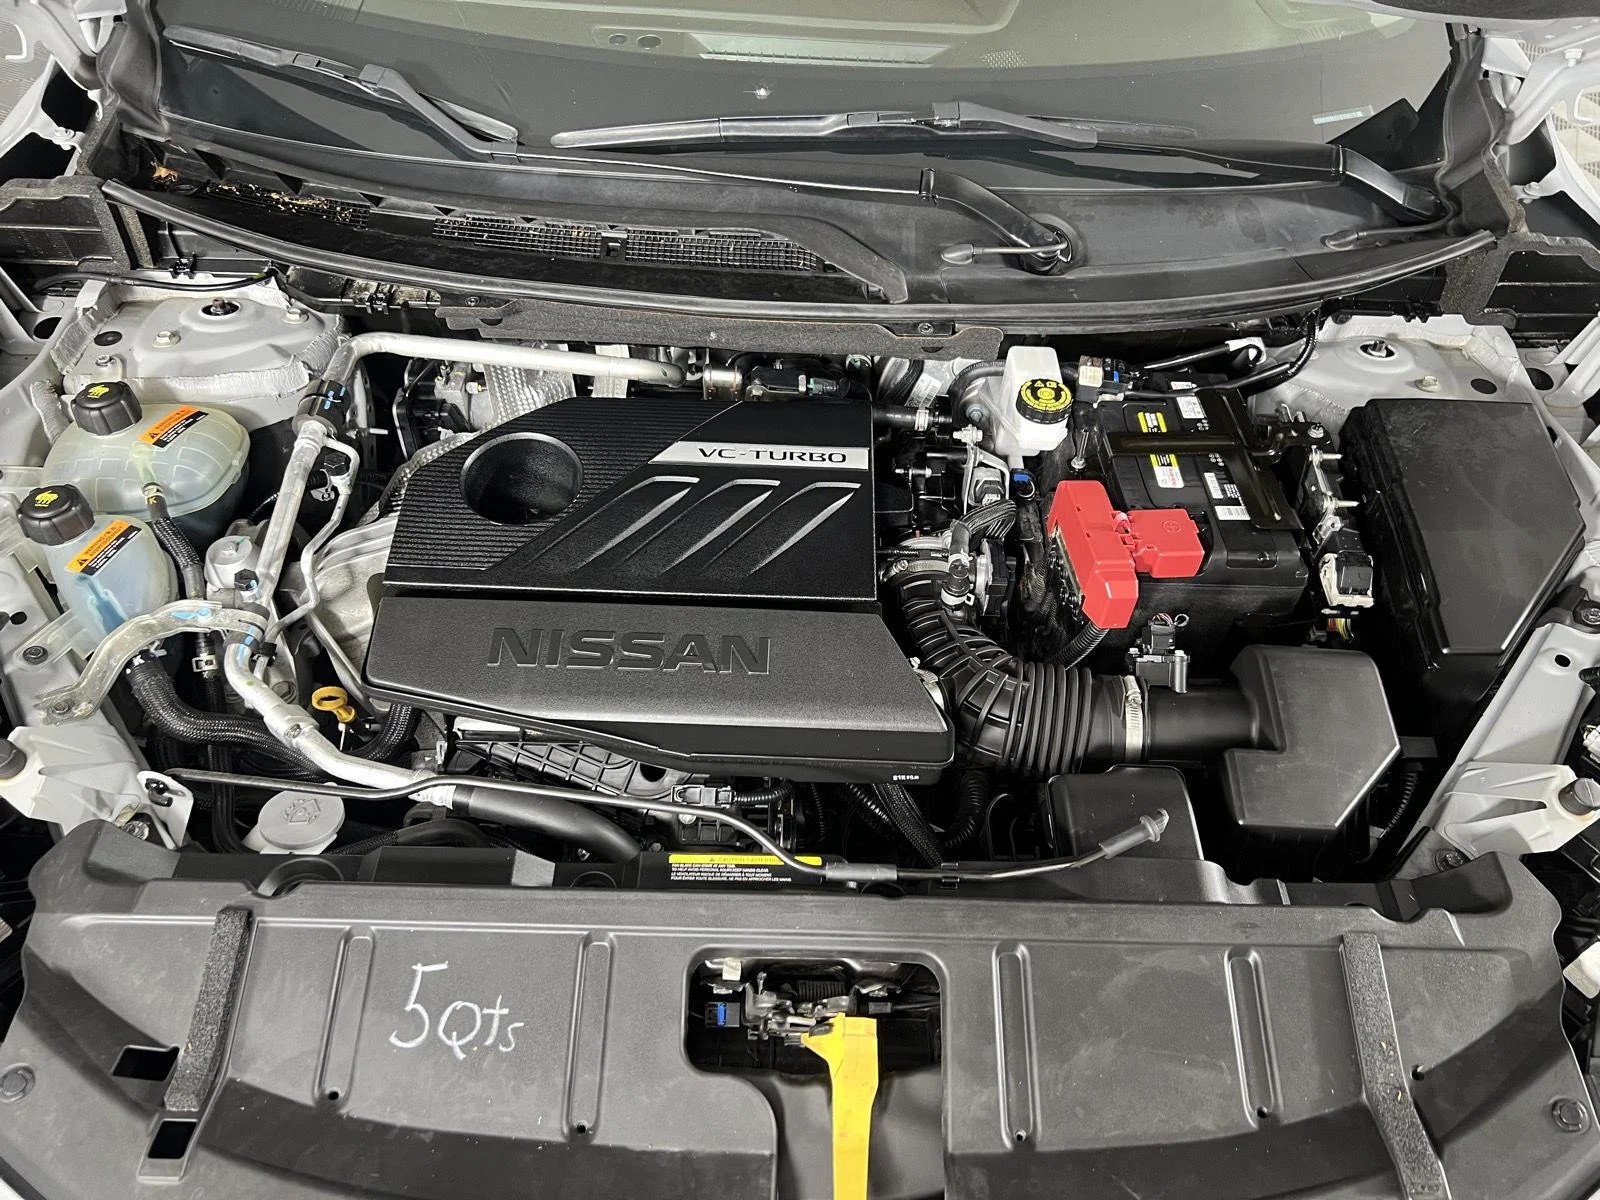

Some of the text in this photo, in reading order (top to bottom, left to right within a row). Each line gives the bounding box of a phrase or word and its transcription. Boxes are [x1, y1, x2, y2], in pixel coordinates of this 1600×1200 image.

[698, 448, 847, 463] VC-TURBO
[487, 627, 770, 674] NISSAN
[389, 961, 524, 1060] 5 Qts
